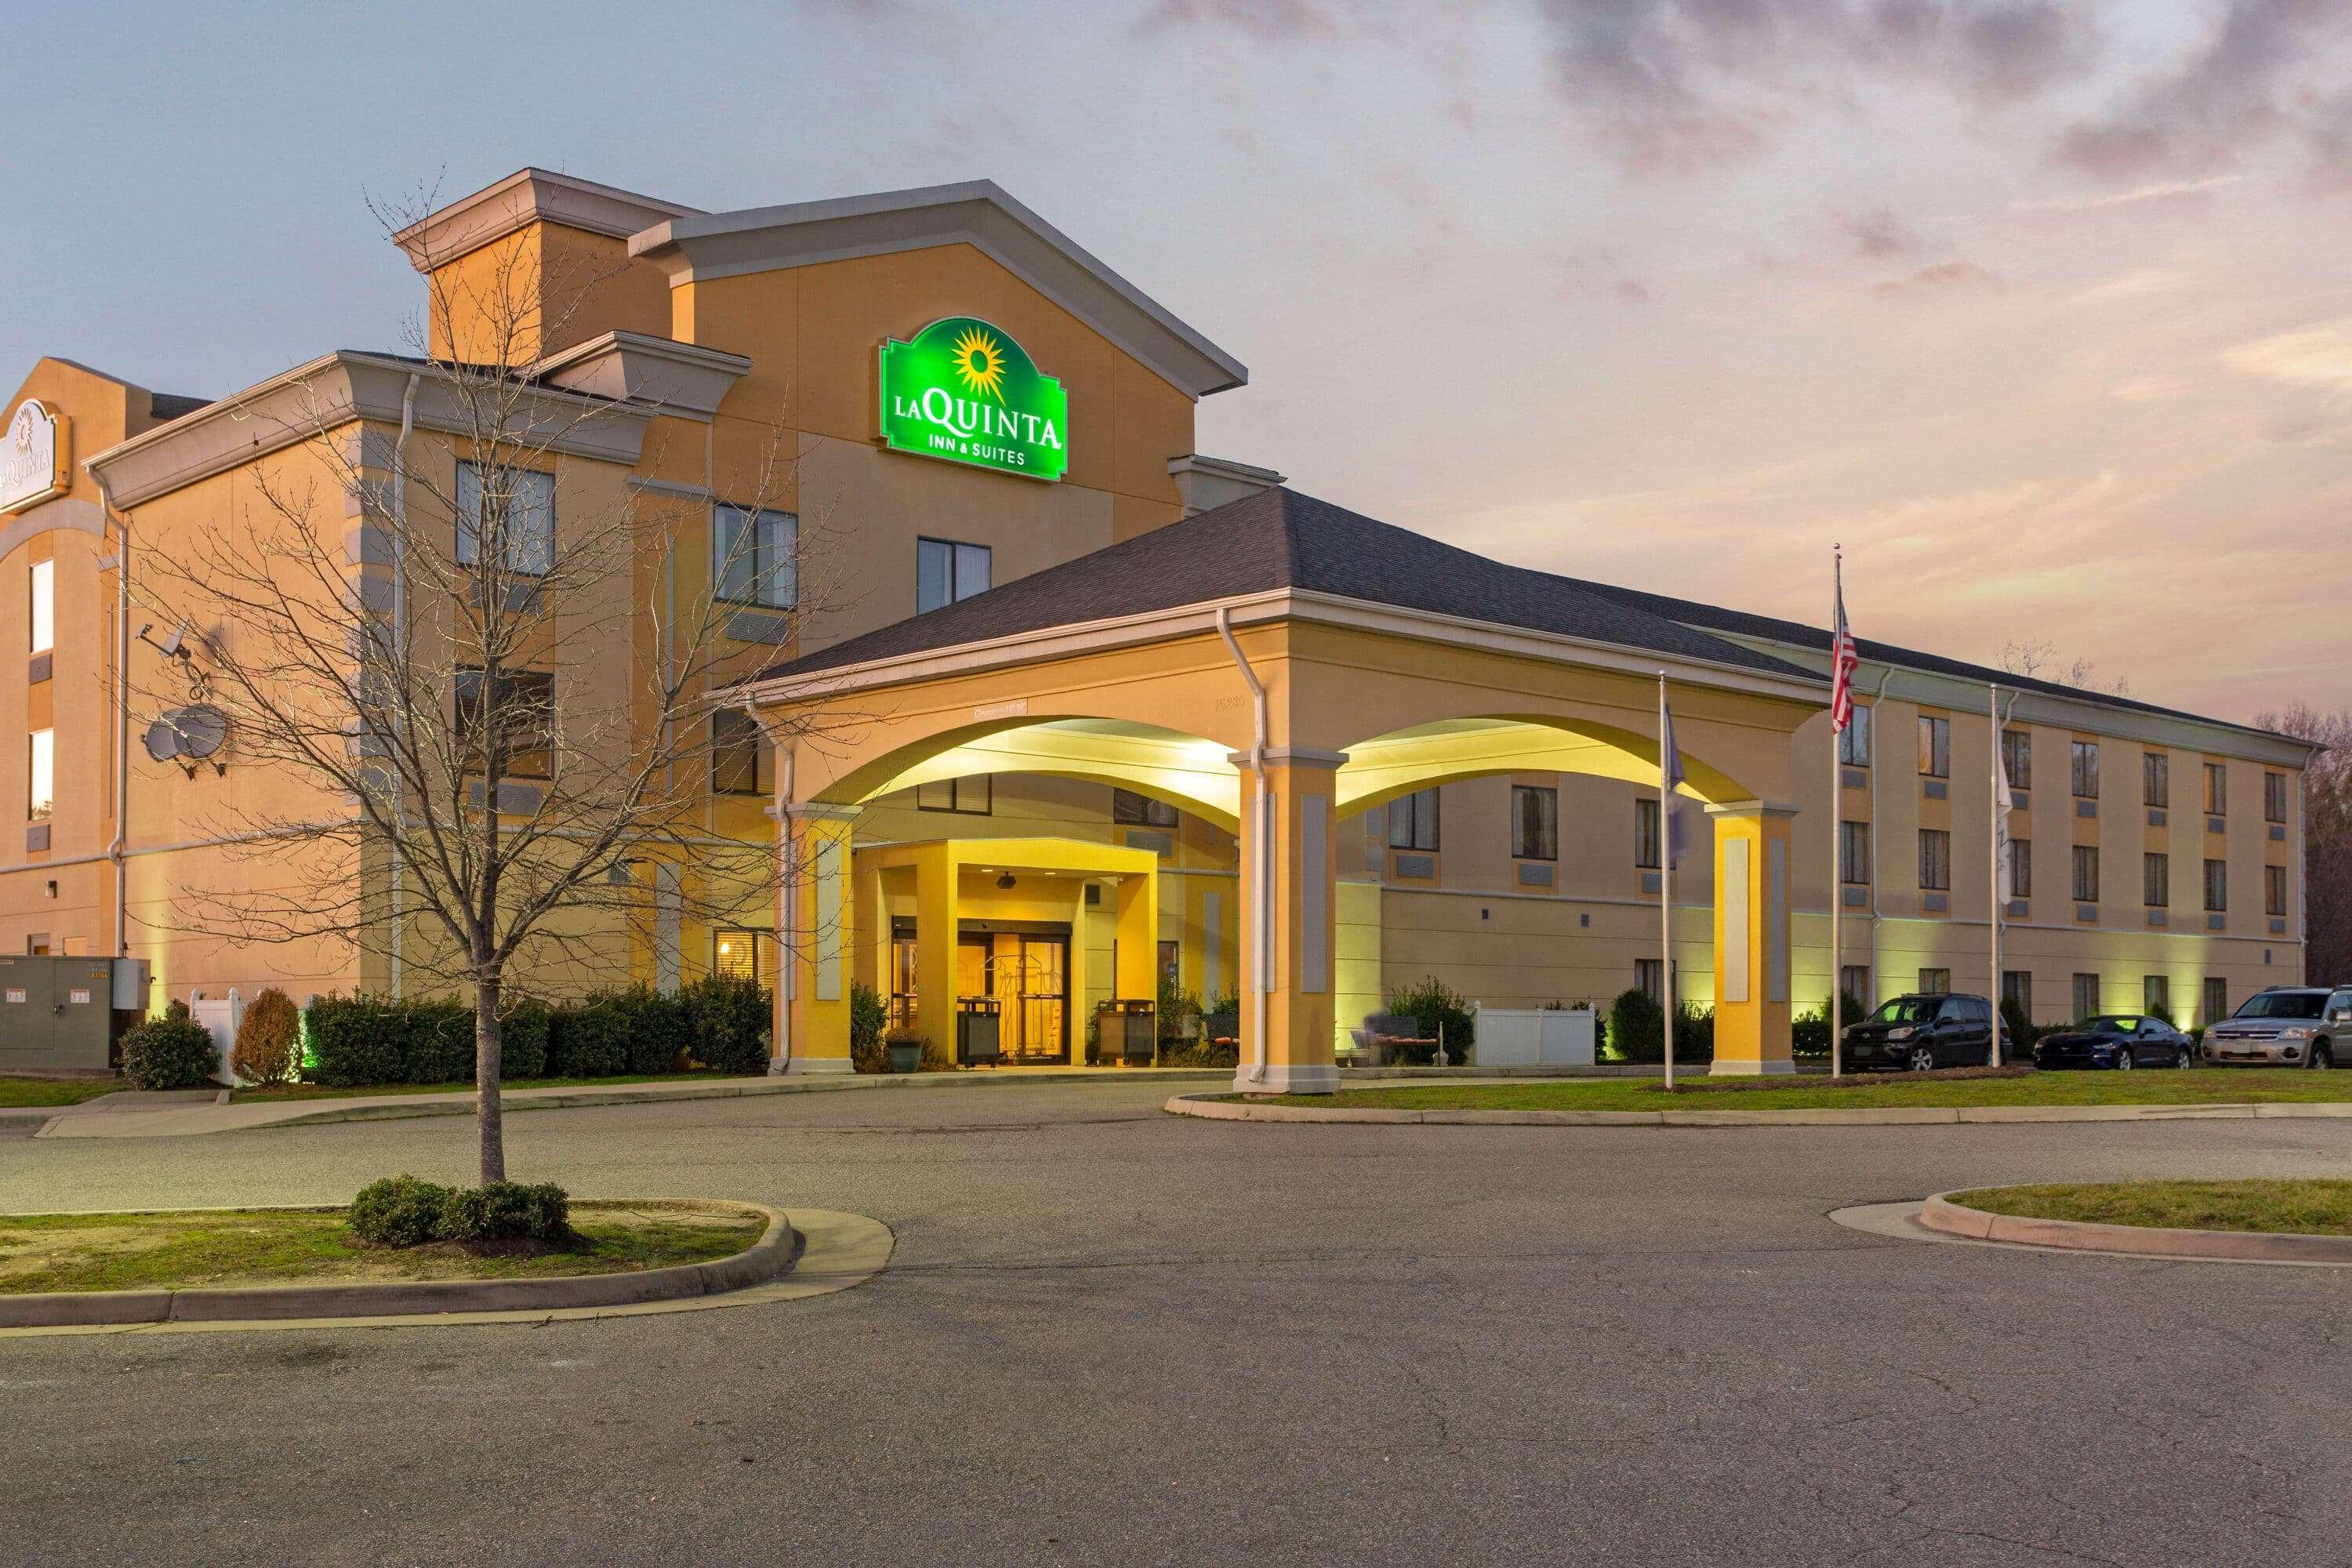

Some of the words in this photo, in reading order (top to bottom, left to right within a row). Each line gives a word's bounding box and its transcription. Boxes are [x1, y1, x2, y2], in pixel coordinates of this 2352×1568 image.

[922, 387, 1062, 450] QUINTA
[929, 434, 956, 452] INN
[960, 442, 968, 454] &
[972, 443, 1025, 466] SUITES
